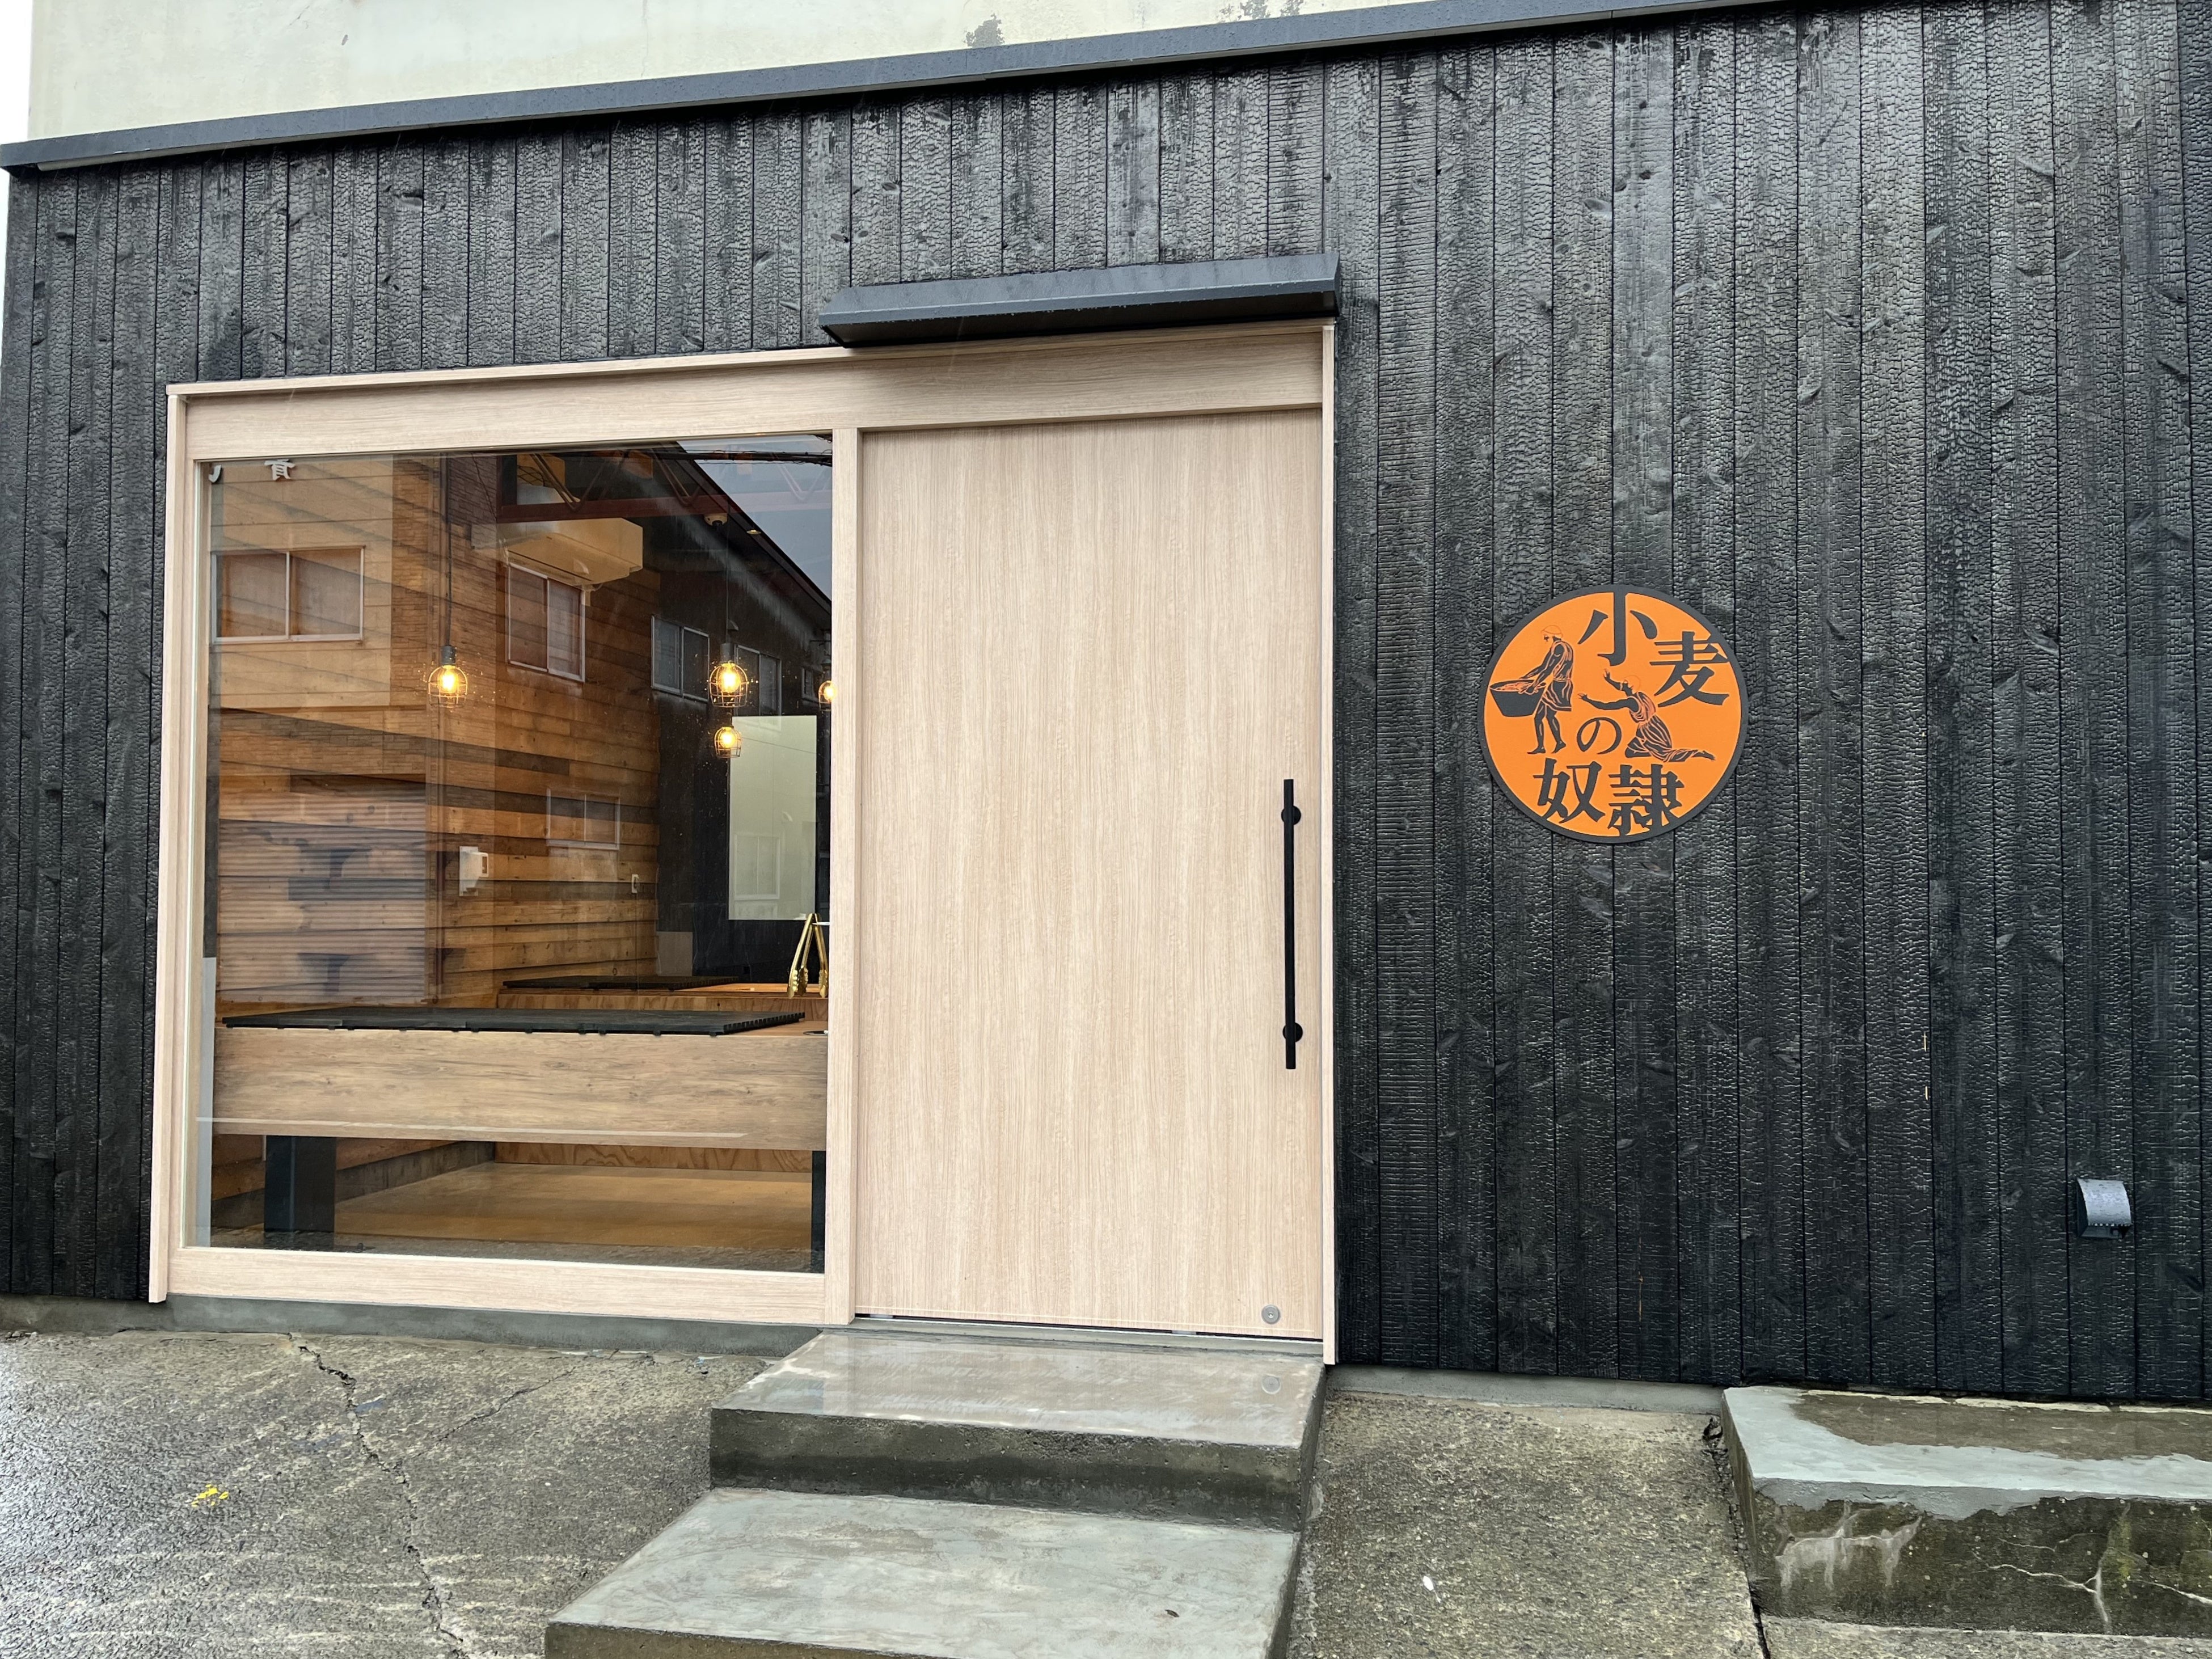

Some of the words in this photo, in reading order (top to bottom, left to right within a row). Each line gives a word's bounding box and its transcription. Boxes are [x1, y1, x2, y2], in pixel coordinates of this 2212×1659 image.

[1577, 592, 1730, 707] 小麦
[1576, 716, 1622, 754] の
[1533, 757, 1685, 837] 奴隷
